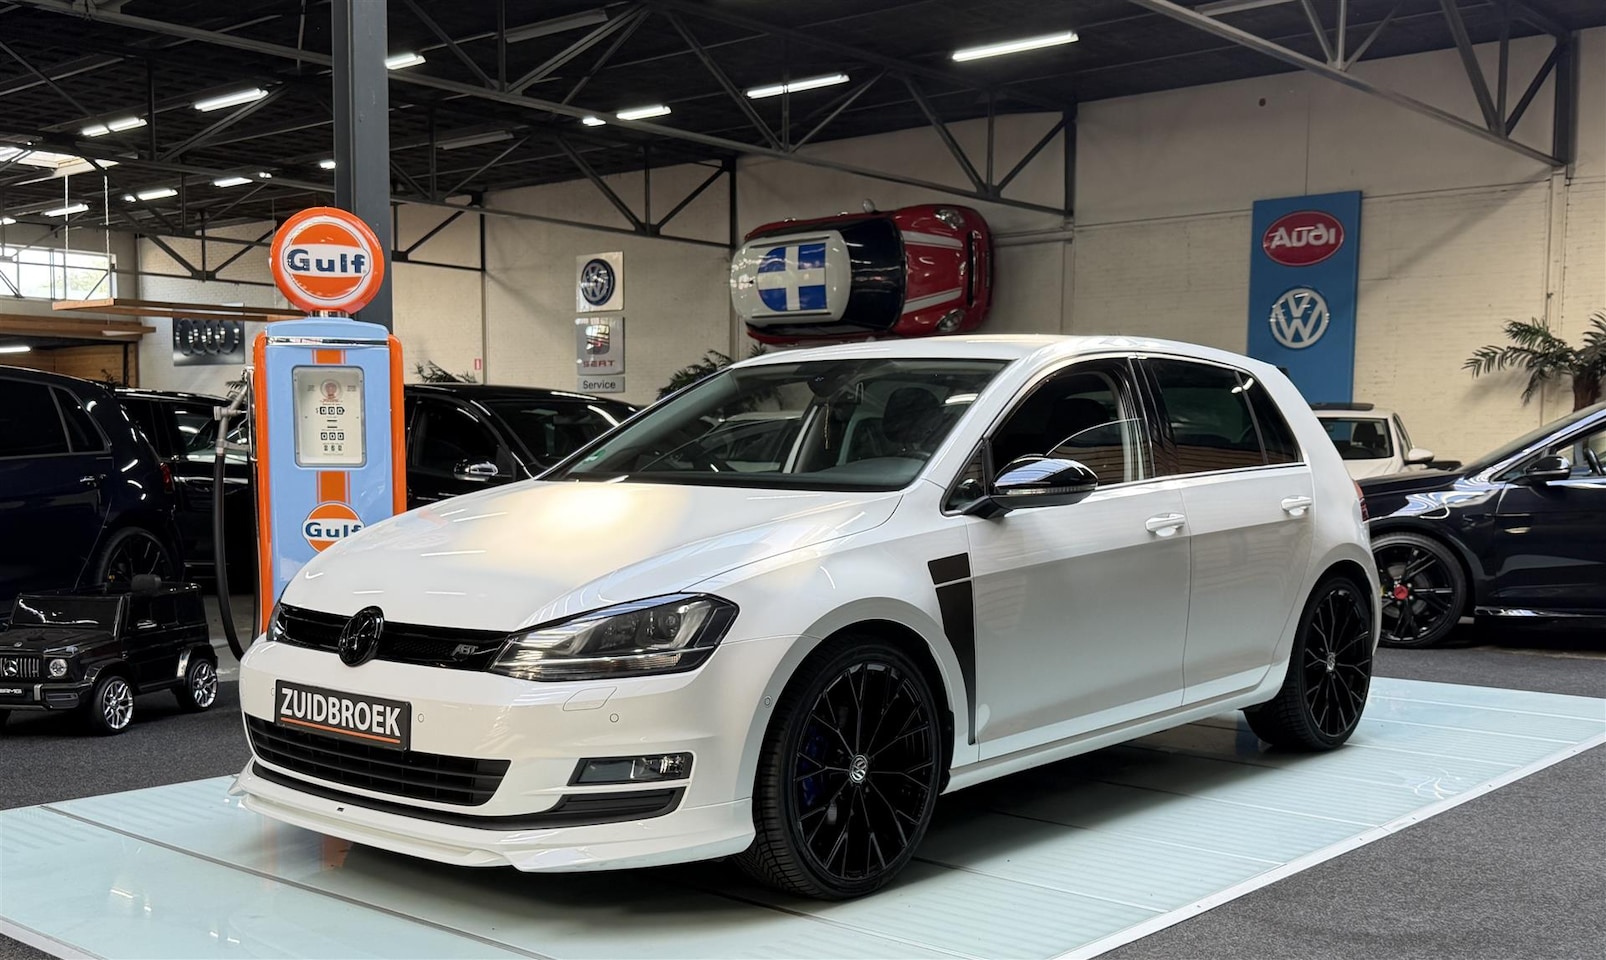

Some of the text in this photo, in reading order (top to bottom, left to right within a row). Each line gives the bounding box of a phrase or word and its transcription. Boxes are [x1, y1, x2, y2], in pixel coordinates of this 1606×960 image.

[287, 249, 365, 273] Gulf
[583, 360, 615, 368] SEAT
[583, 380, 616, 390] Service
[305, 522, 361, 538] Gulf
[451, 643, 479, 656] ABT
[281, 687, 400, 736] ZUIDBROEK
